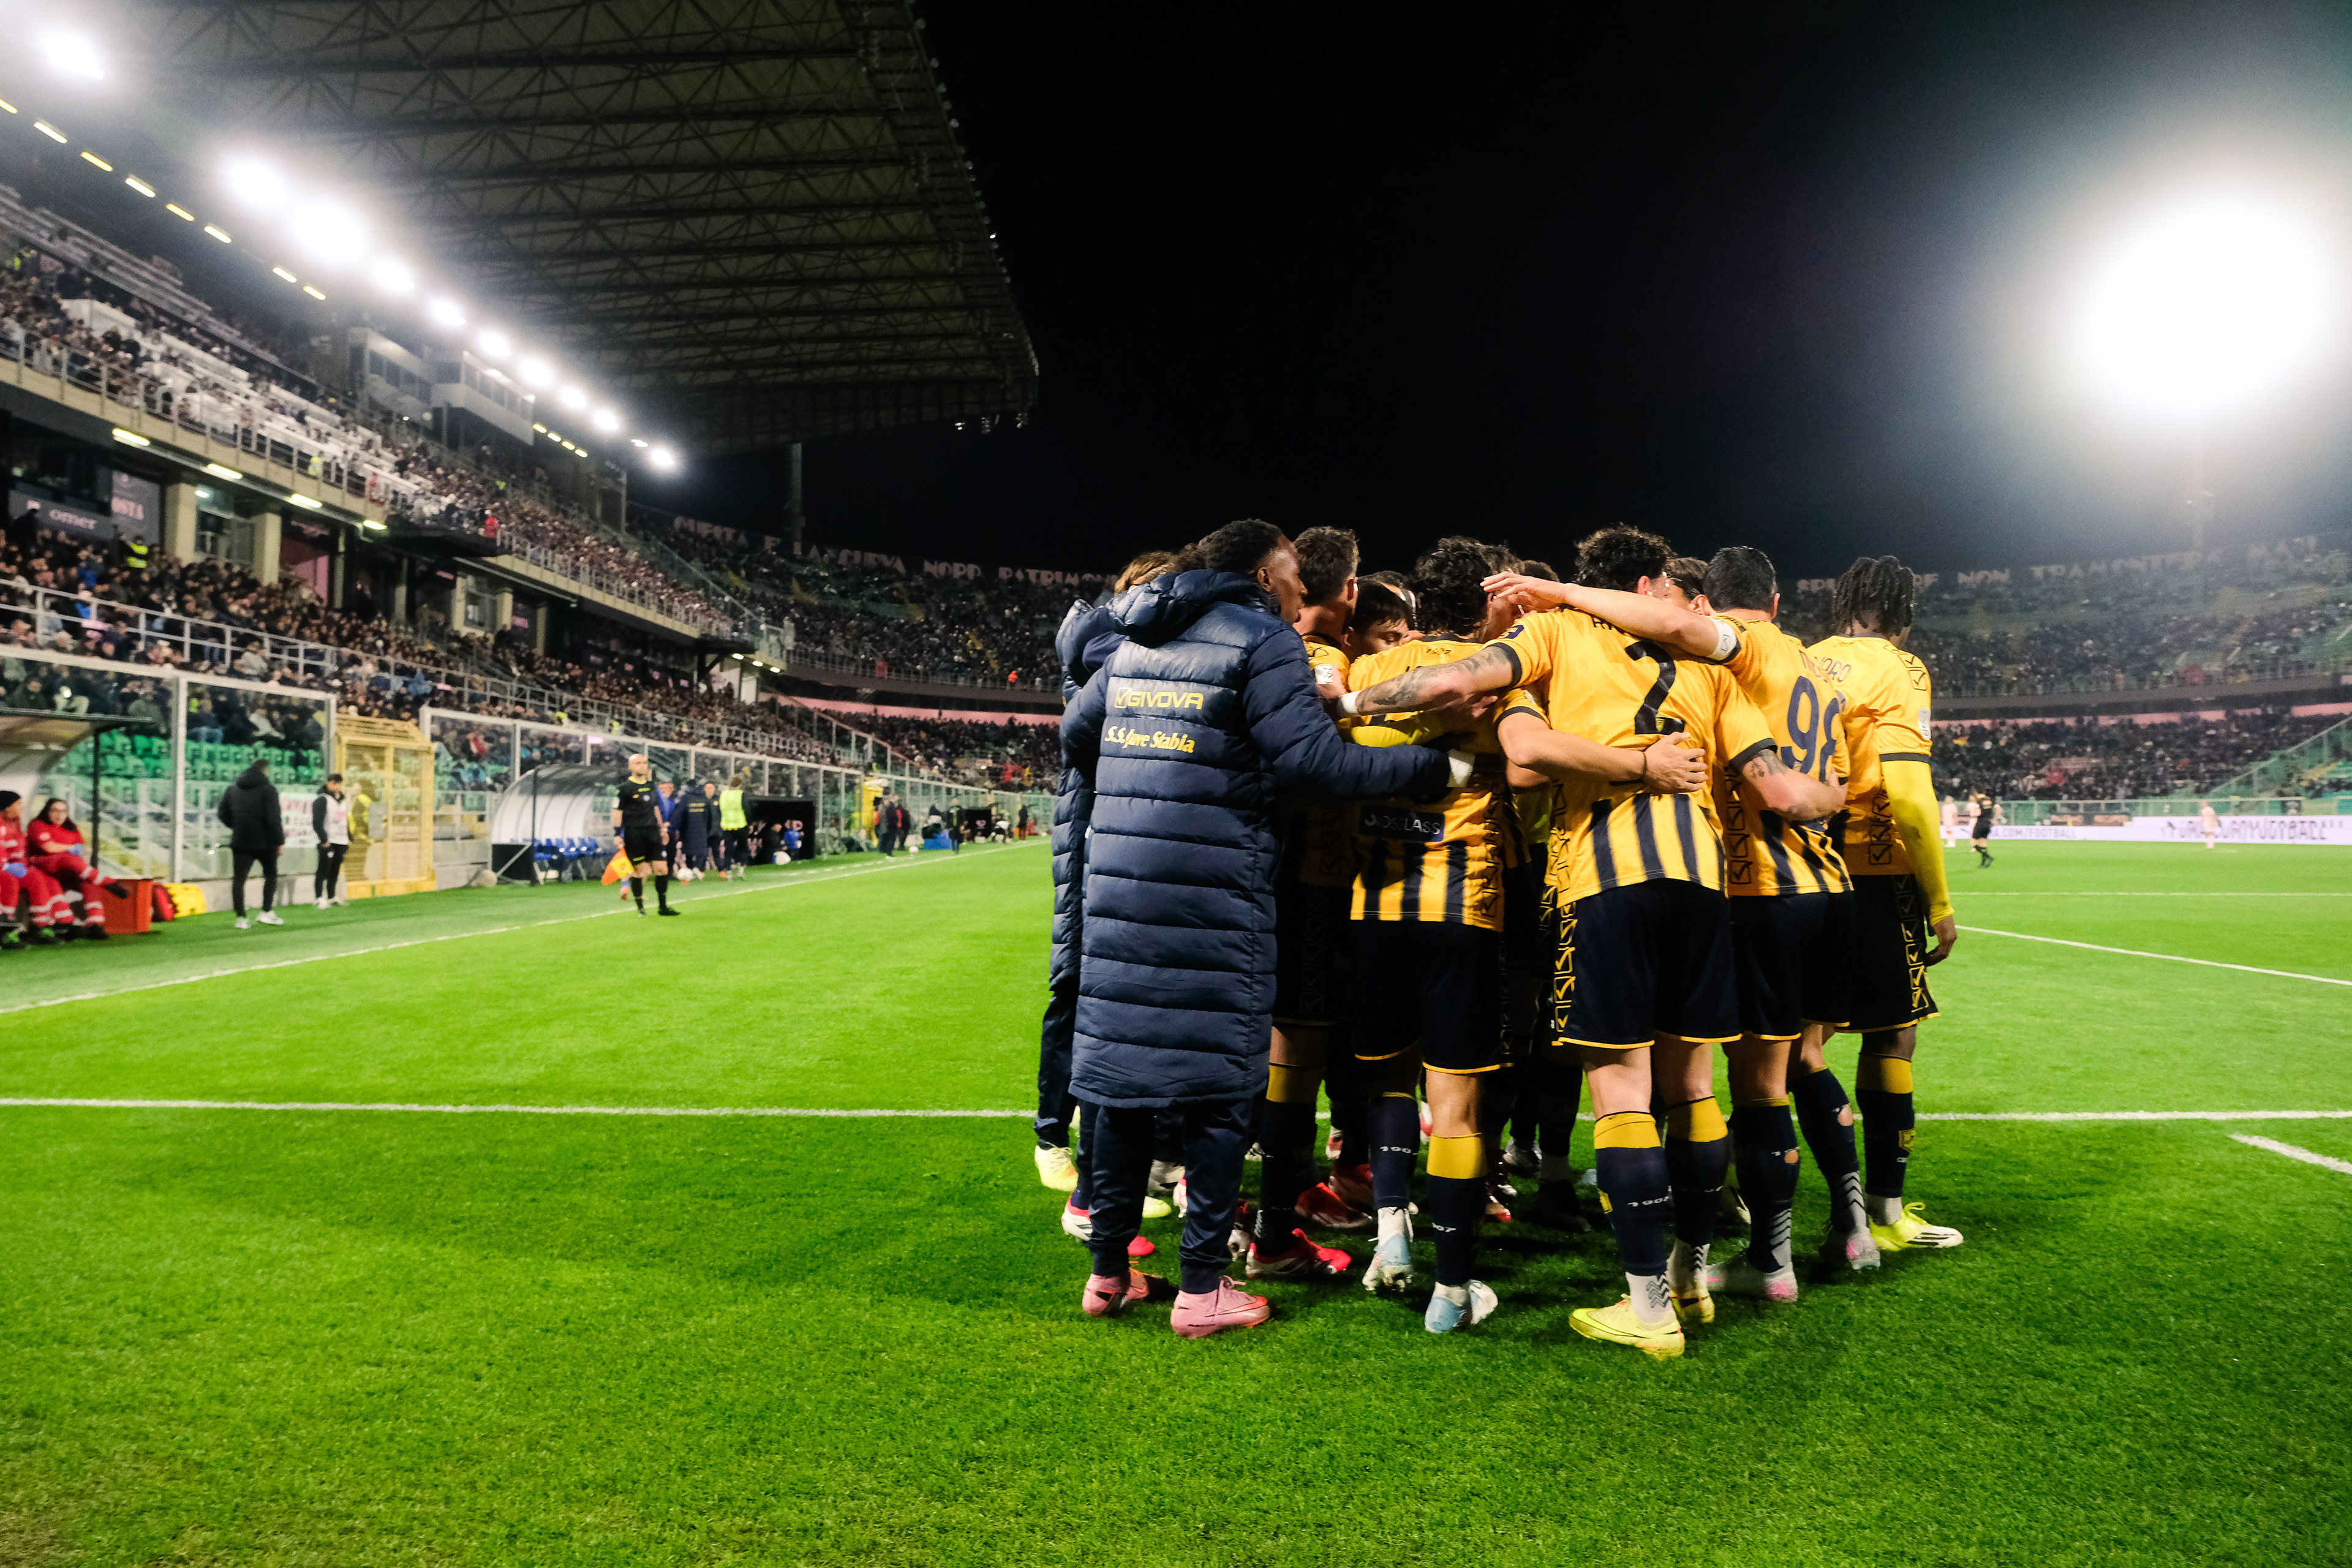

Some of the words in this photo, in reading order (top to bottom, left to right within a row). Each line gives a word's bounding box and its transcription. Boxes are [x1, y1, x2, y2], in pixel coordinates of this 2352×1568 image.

[1624, 641, 1687, 736] 2
[1127, 691, 1204, 710] GIVOVA
[1150, 731, 1195, 753] Stabia
[1379, 1145, 1412, 1154] 190
